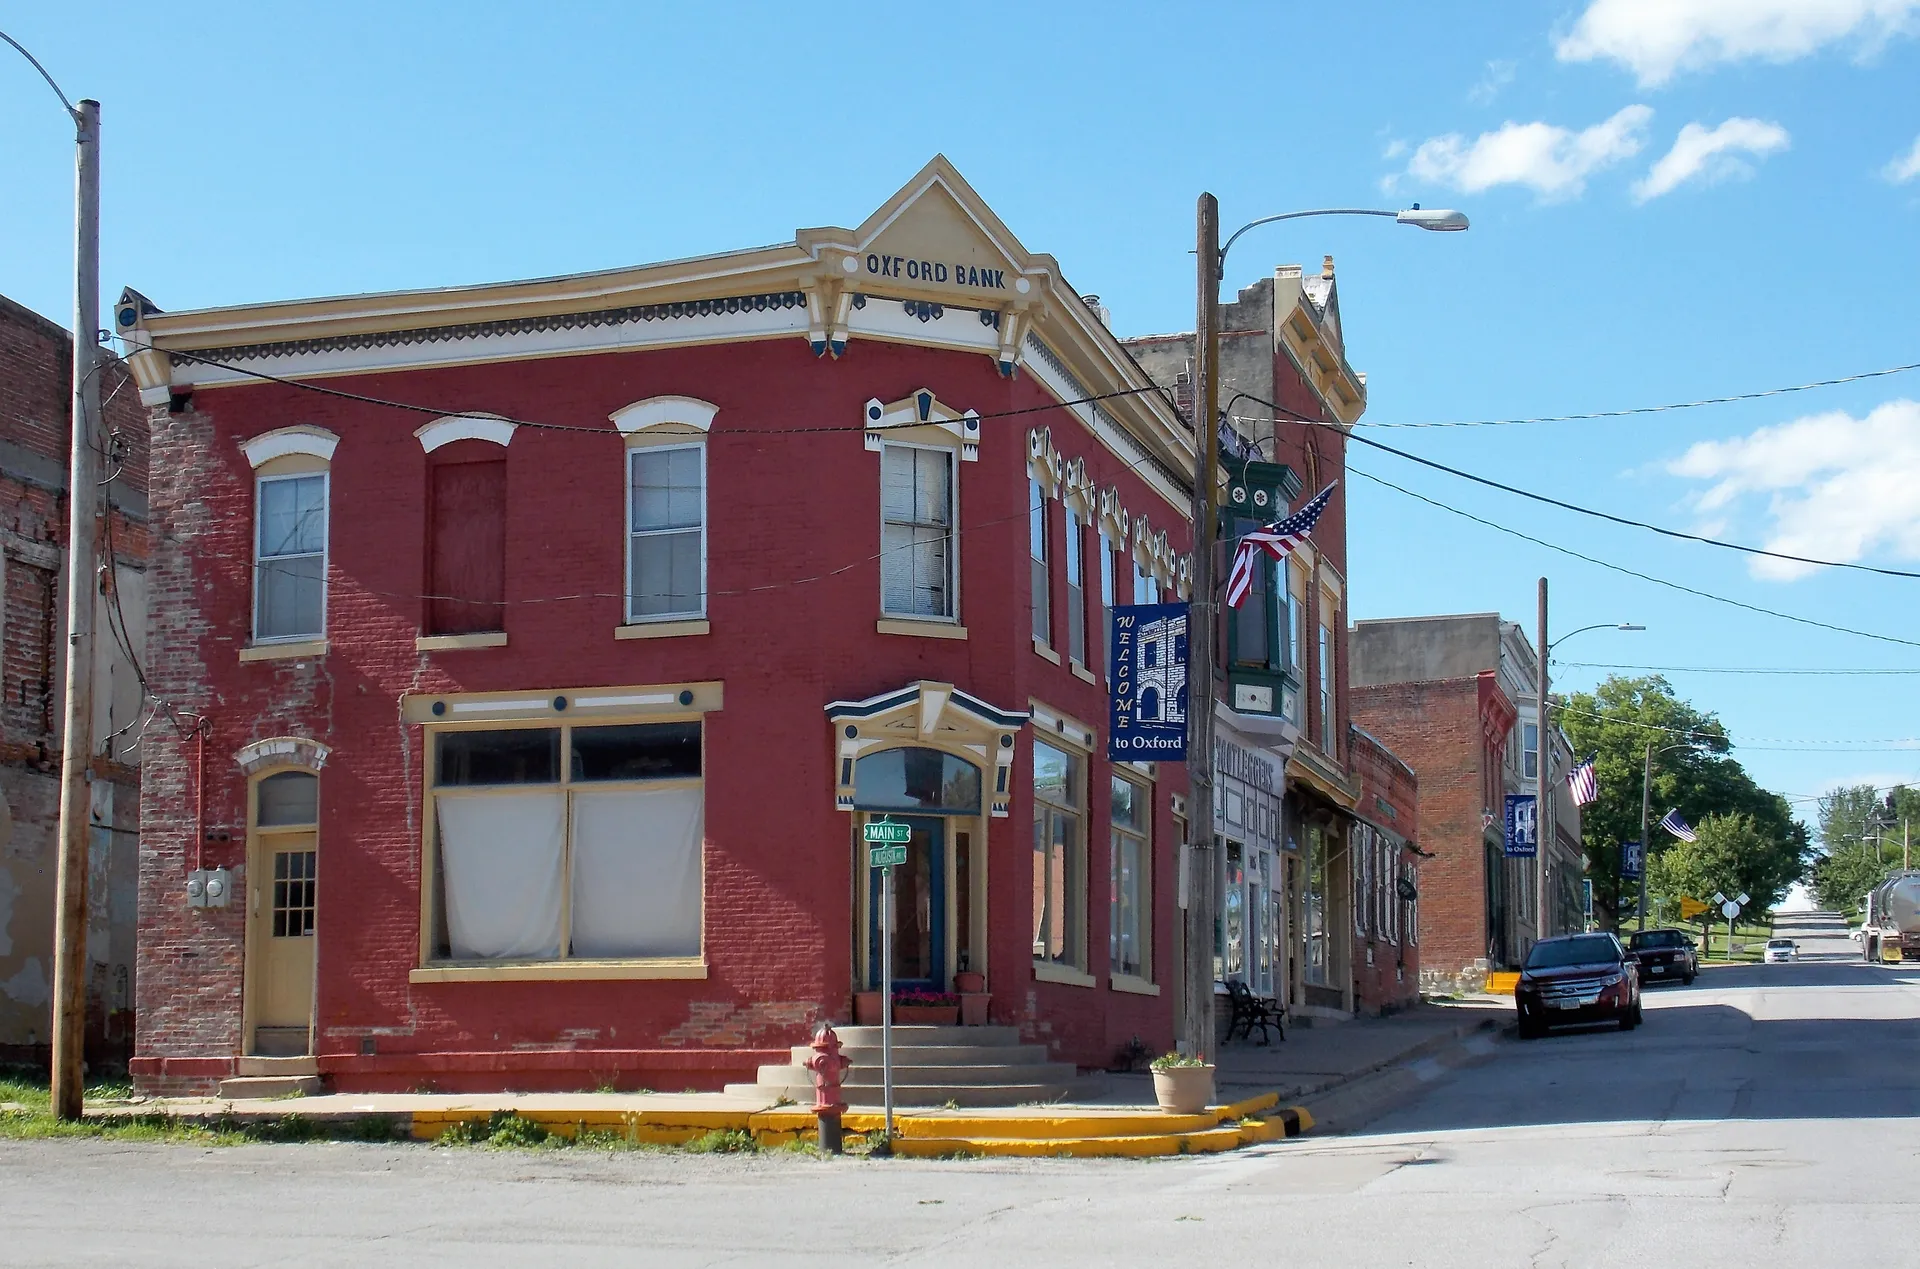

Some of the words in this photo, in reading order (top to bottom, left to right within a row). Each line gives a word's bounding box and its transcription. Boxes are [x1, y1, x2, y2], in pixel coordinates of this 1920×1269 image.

[866, 253, 948, 283] OXFORD
[955, 265, 1006, 290] BANK
[1115, 615, 1136, 728] WELCOME
[1115, 737, 1129, 749] to
[1132, 736, 1182, 749] Oxford
[870, 826, 895, 840] MAIN
